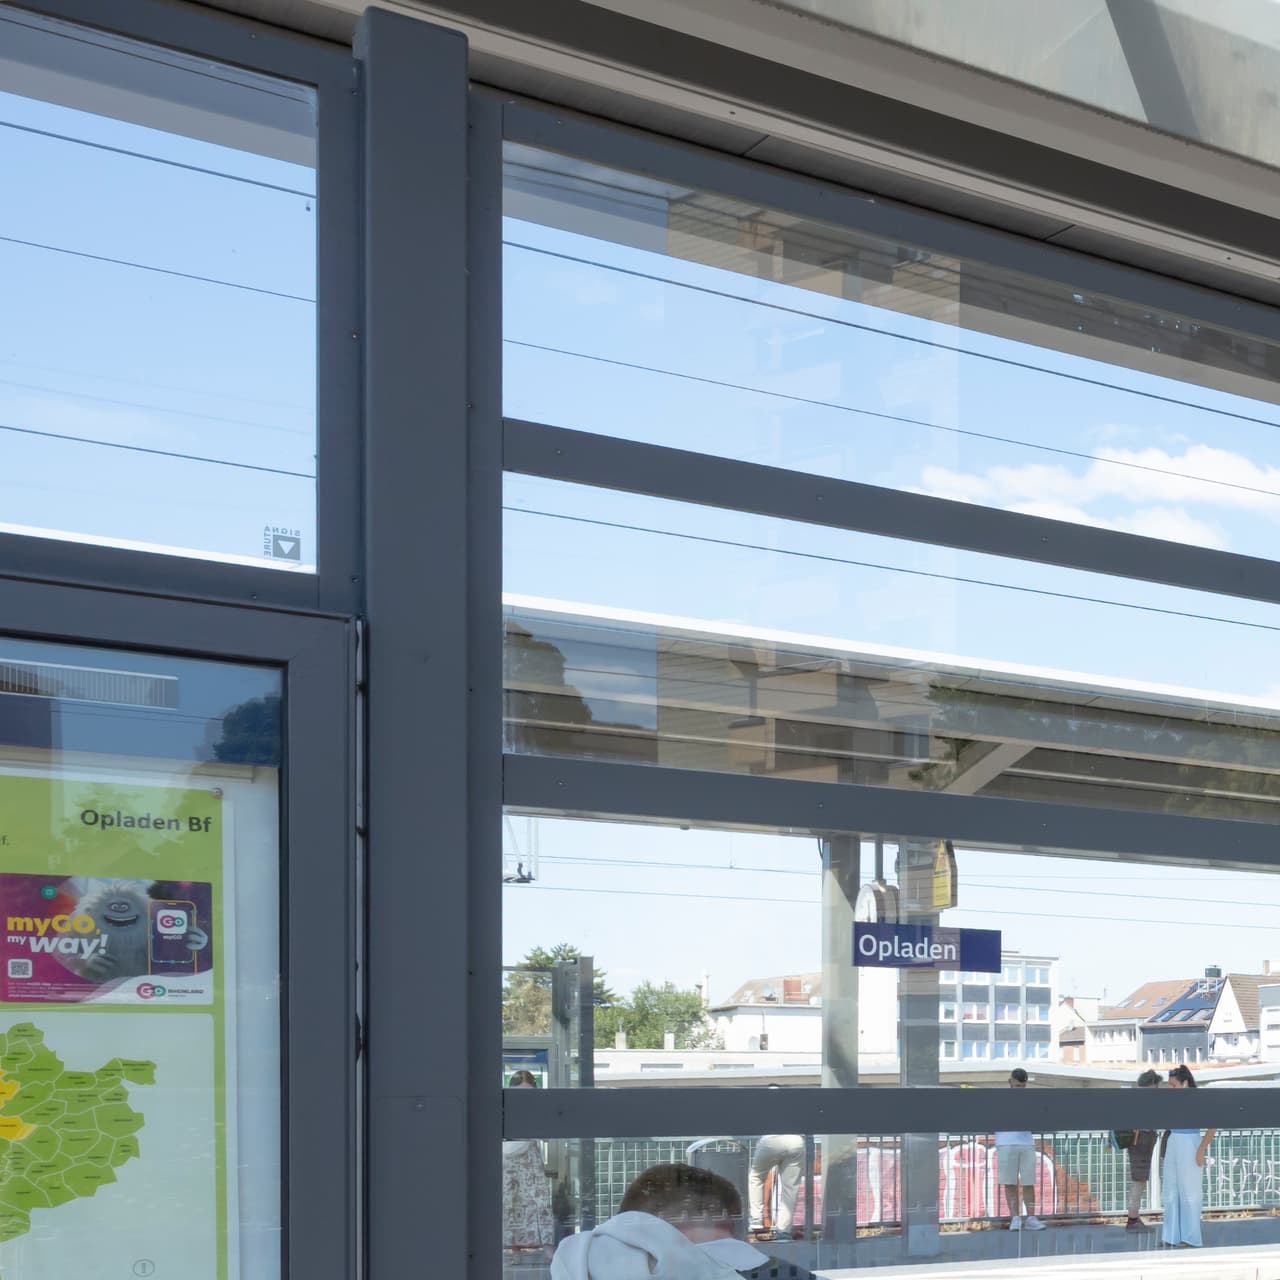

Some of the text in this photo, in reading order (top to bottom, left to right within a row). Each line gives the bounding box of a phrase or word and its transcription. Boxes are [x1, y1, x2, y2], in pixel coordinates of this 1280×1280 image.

[80, 808, 213, 833] Opladen Bf
[7, 914, 101, 937] myGO,
[7, 933, 109, 960] my way!
[858, 933, 957, 962] Opladen
